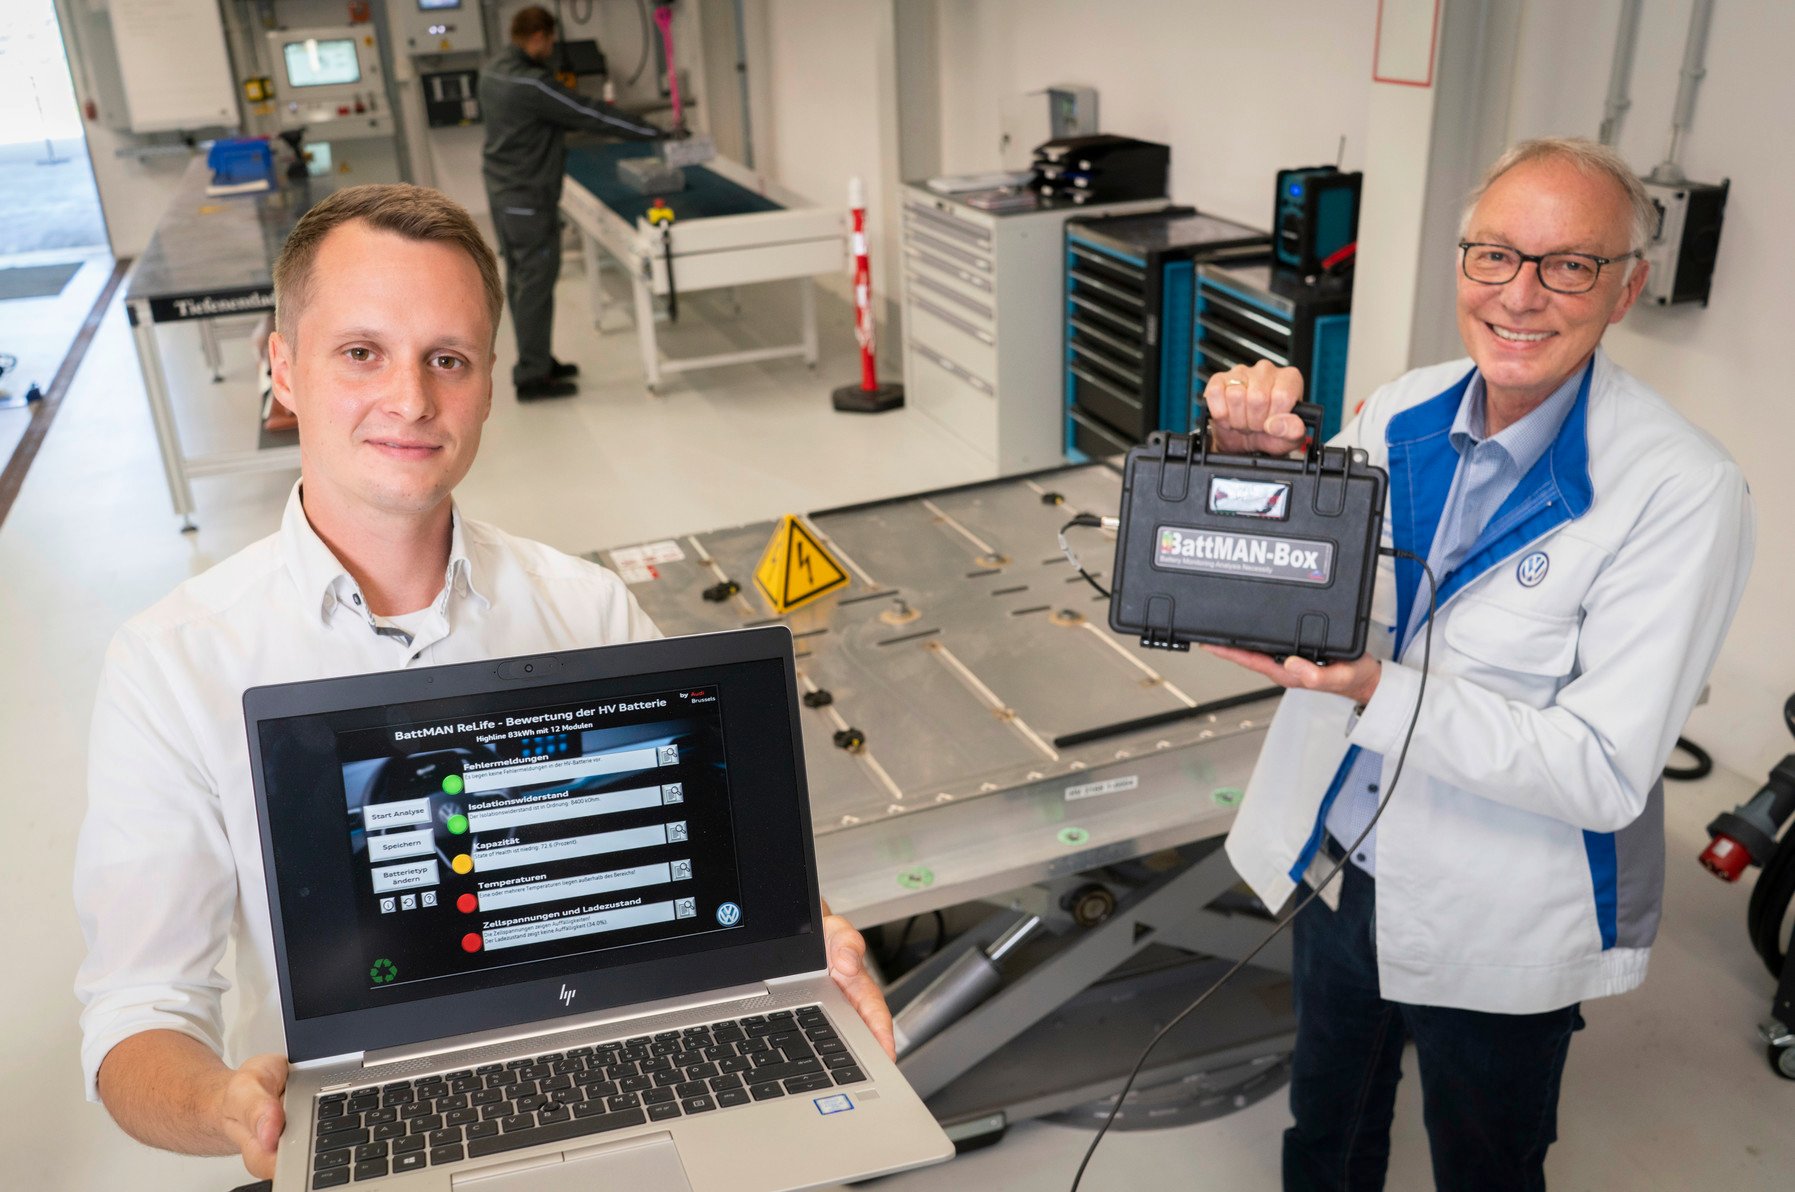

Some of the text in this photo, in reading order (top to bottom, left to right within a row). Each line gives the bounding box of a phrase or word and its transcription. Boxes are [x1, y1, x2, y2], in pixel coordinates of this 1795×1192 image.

[1161, 530, 1319, 570] BattMAN-Box
[691, 696, 716, 704] Brussels
[394, 725, 454, 740] BattMAN
[457, 720, 496, 732] ReLife
[506, 712, 572, 727] Bewertung
[576, 708, 596, 718] der
[598, 704, 616, 715] HV
[618, 699, 667, 712] Batterie
[476, 733, 506, 744] Highline
[508, 730, 534, 738] 83kWh
[562, 722, 593, 732] Modulen
[464, 754, 549, 771] Fehlermeldungen
[504, 765, 548, 774] Fehlermeldungen
[468, 790, 569, 810] Isolationswiderstand
[372, 808, 424, 820] Start Analyse
[480, 806, 532, 818] Isolationswiderstand
[382, 840, 422, 852] Speichern
[474, 837, 520, 850] Kapazität
[383, 867, 428, 879] Batterietyp
[392, 876, 420, 885] ändern
[478, 874, 547, 889] Temperaturen
[526, 881, 561, 891] Temperaturen
[482, 898, 642, 929] Zellspannungen und Ladezustand
[718, 903, 740, 926] VW
[560, 984, 576, 1006] hp
